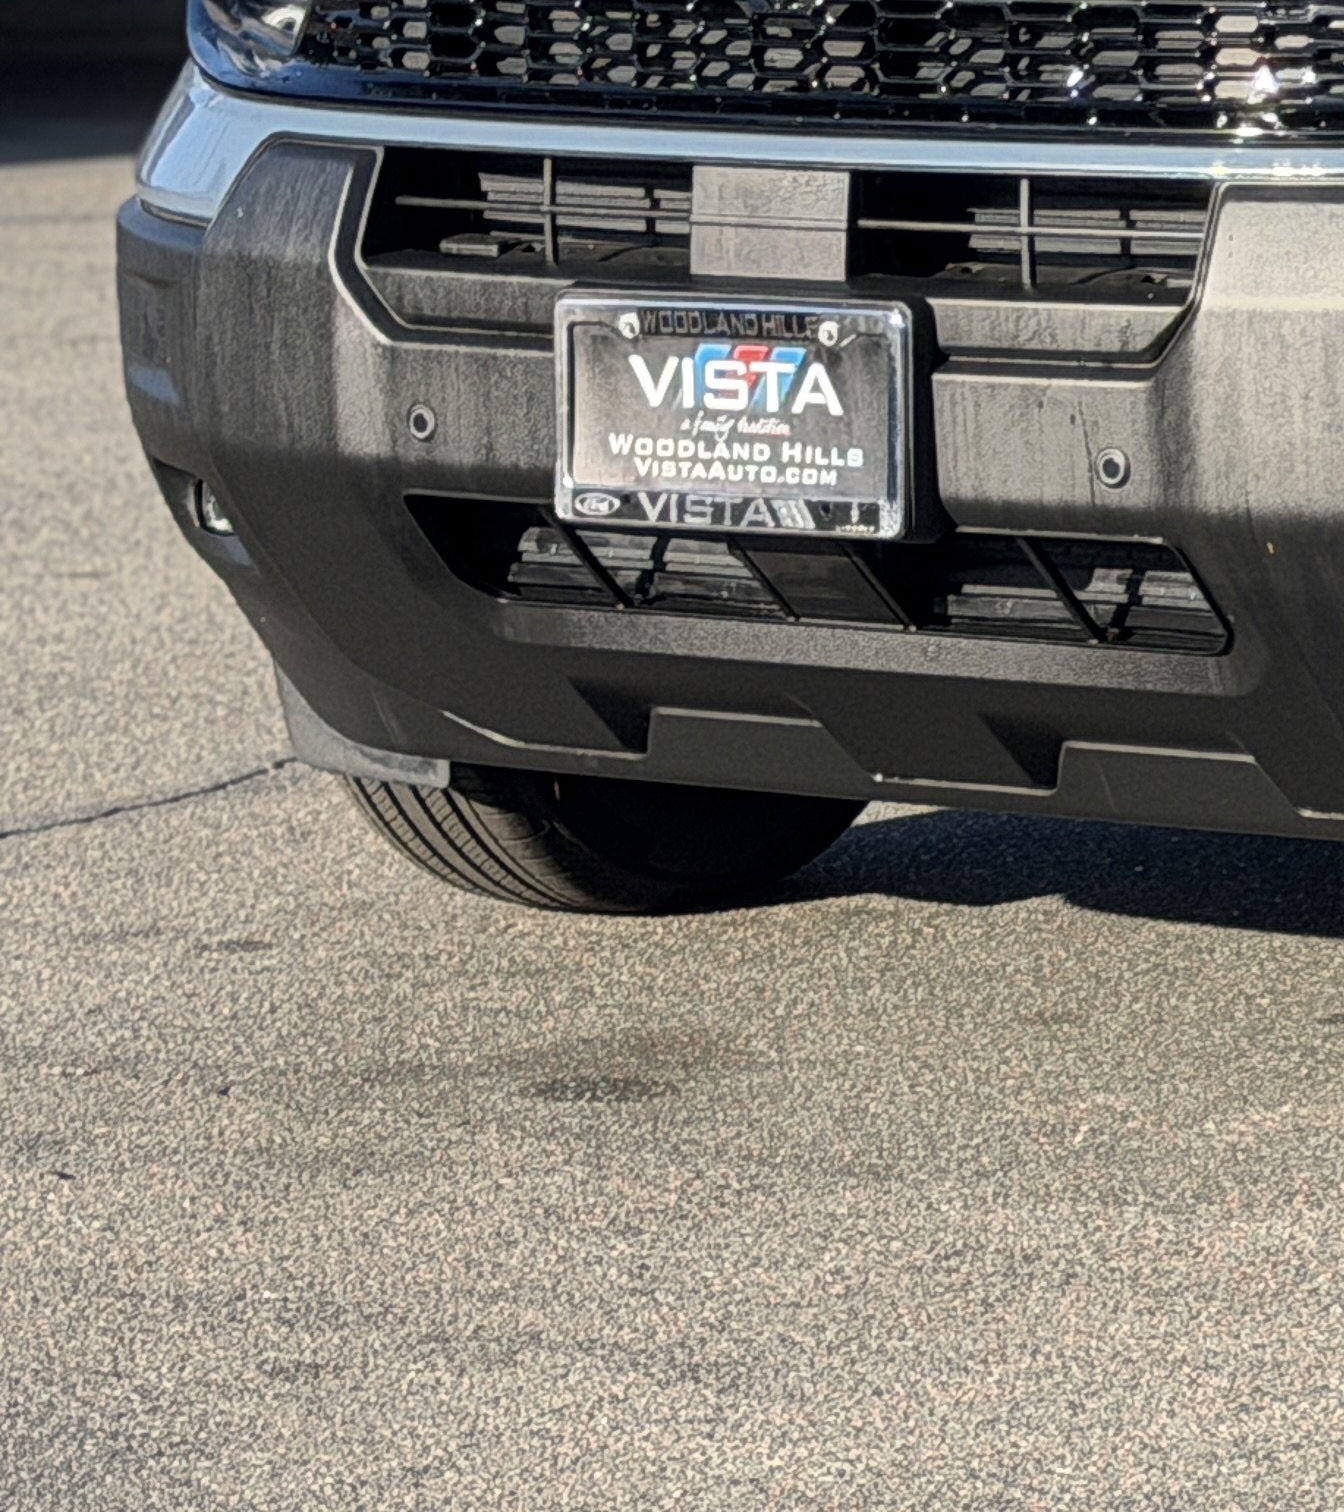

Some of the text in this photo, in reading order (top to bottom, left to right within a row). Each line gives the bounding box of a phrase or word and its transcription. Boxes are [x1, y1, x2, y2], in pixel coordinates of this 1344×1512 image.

[641, 309, 759, 337] WOODLAND
[628, 354, 844, 416] VISTA
[609, 433, 865, 467] WOODLAND HILLS
[636, 491, 776, 528] VISTA
